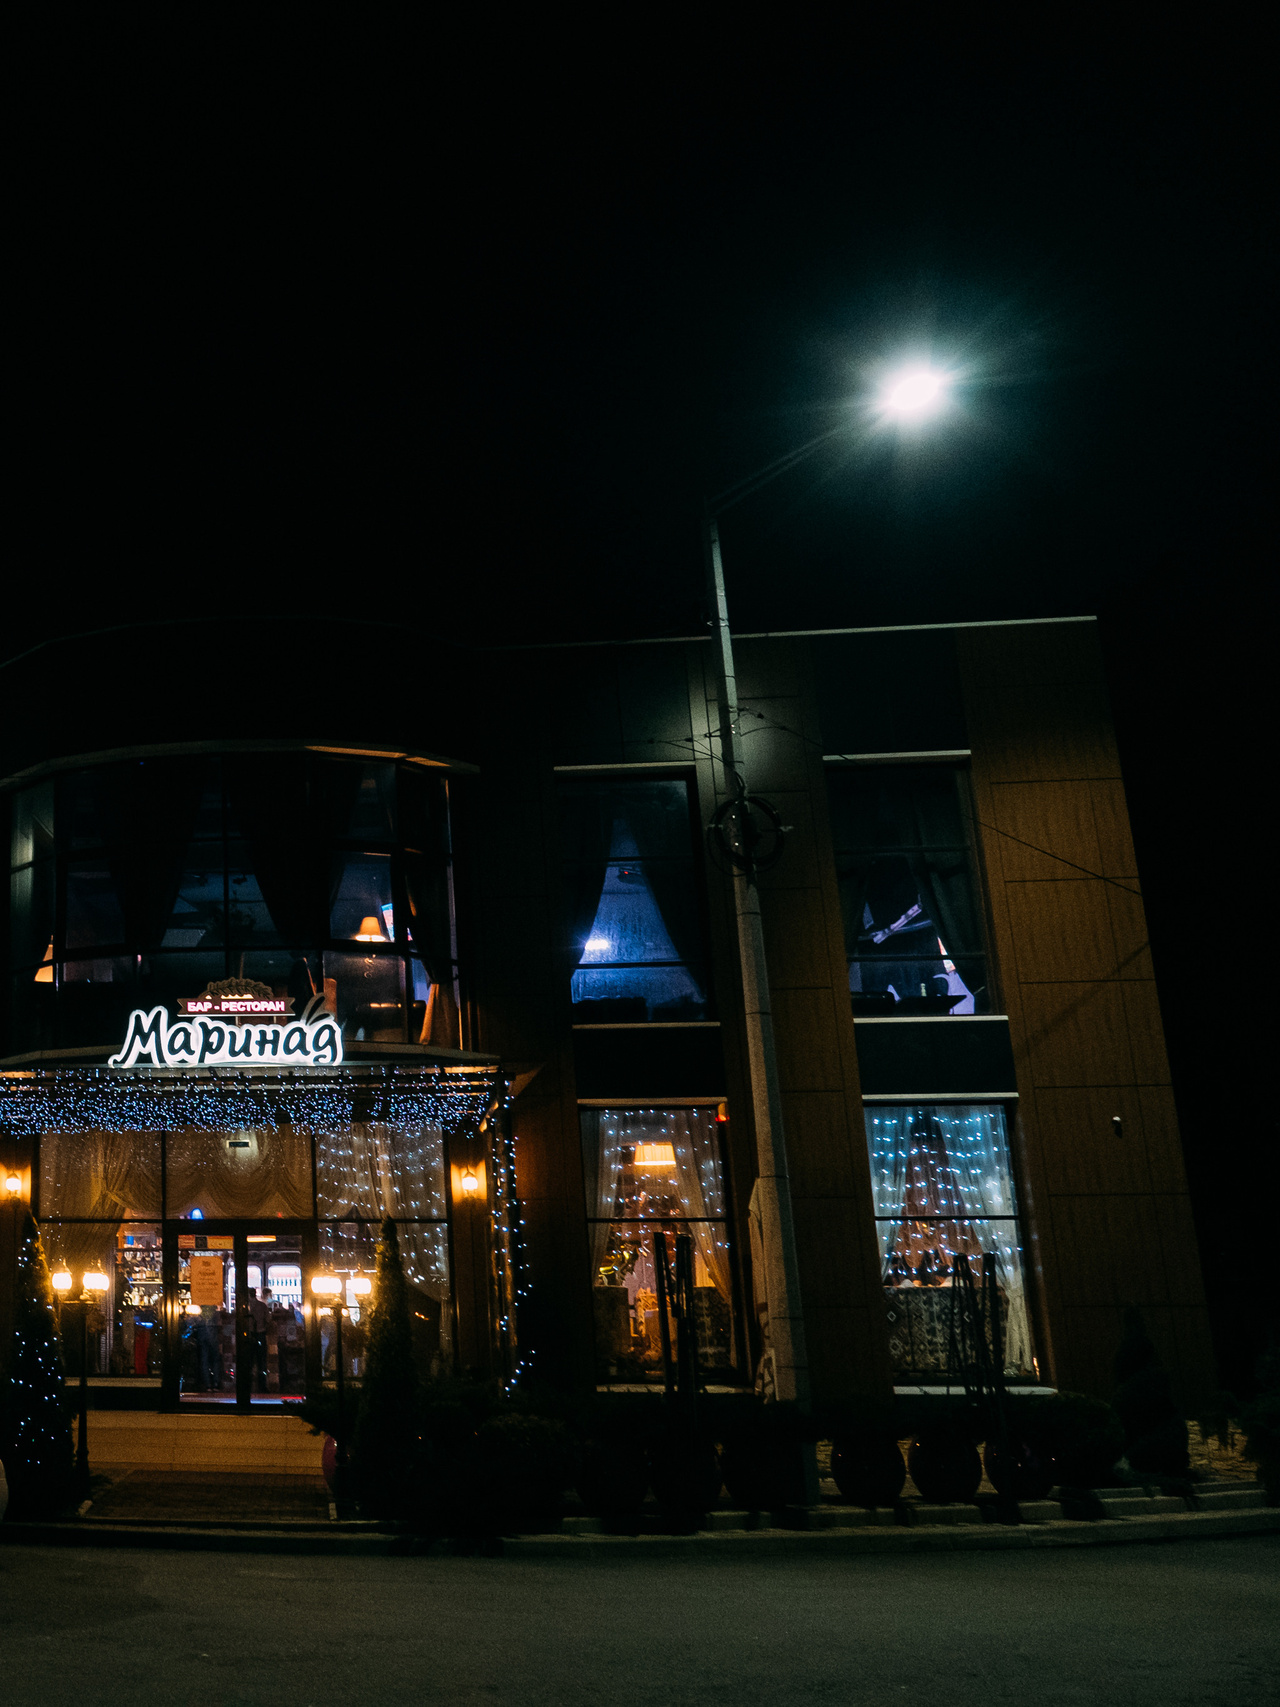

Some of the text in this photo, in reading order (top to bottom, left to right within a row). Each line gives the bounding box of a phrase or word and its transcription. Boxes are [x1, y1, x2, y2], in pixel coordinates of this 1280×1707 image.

[187, 1001, 213, 1012] БАР
[221, 1001, 286, 1012] РЕСТОРАН
[108, 1006, 343, 1069] Маринад
